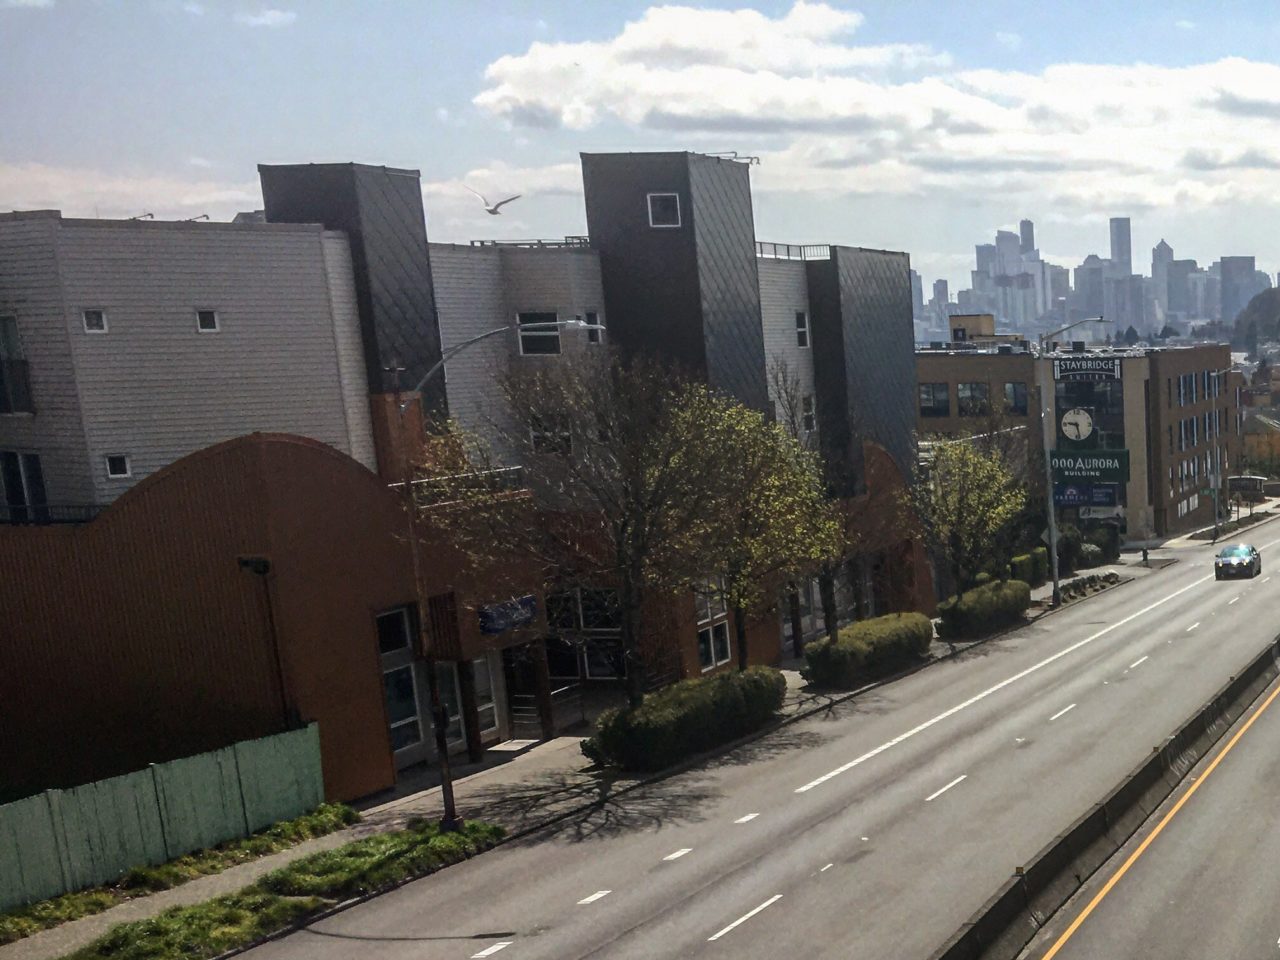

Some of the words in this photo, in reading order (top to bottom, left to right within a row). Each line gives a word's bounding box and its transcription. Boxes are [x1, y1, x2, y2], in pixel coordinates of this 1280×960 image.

[1060, 360, 1114, 370] STAYBRIDGE
[1052, 458, 1074, 468] 000
[1075, 457, 1120, 470] AURORA
